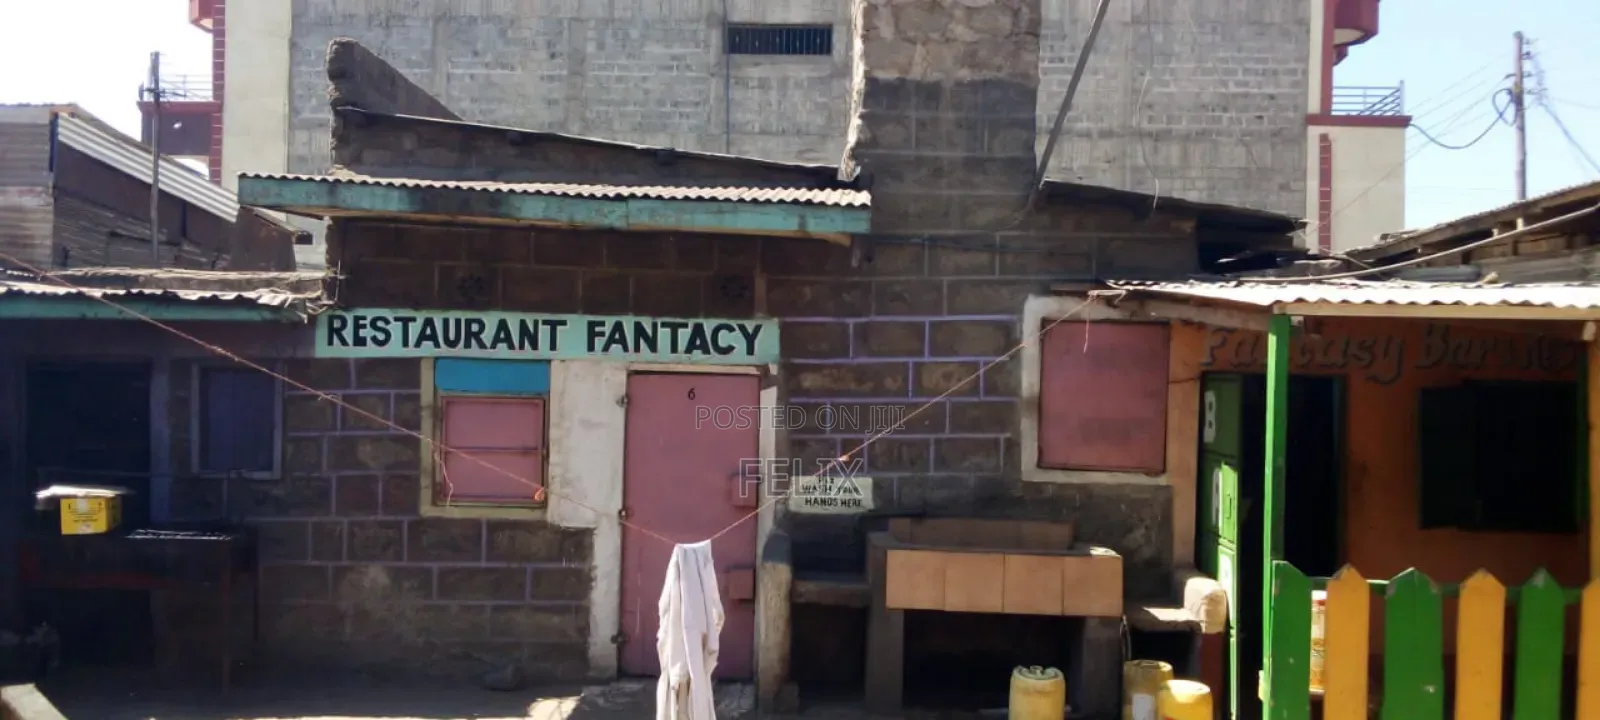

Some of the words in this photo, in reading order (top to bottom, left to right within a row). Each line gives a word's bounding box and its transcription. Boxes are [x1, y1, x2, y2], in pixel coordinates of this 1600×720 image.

[327, 314, 567, 351] RESTAURANT
[587, 320, 764, 356] FANTACY
[687, 388, 696, 401] 6
[804, 497, 839, 507] HANDS
[840, 498, 862, 508] HERE
